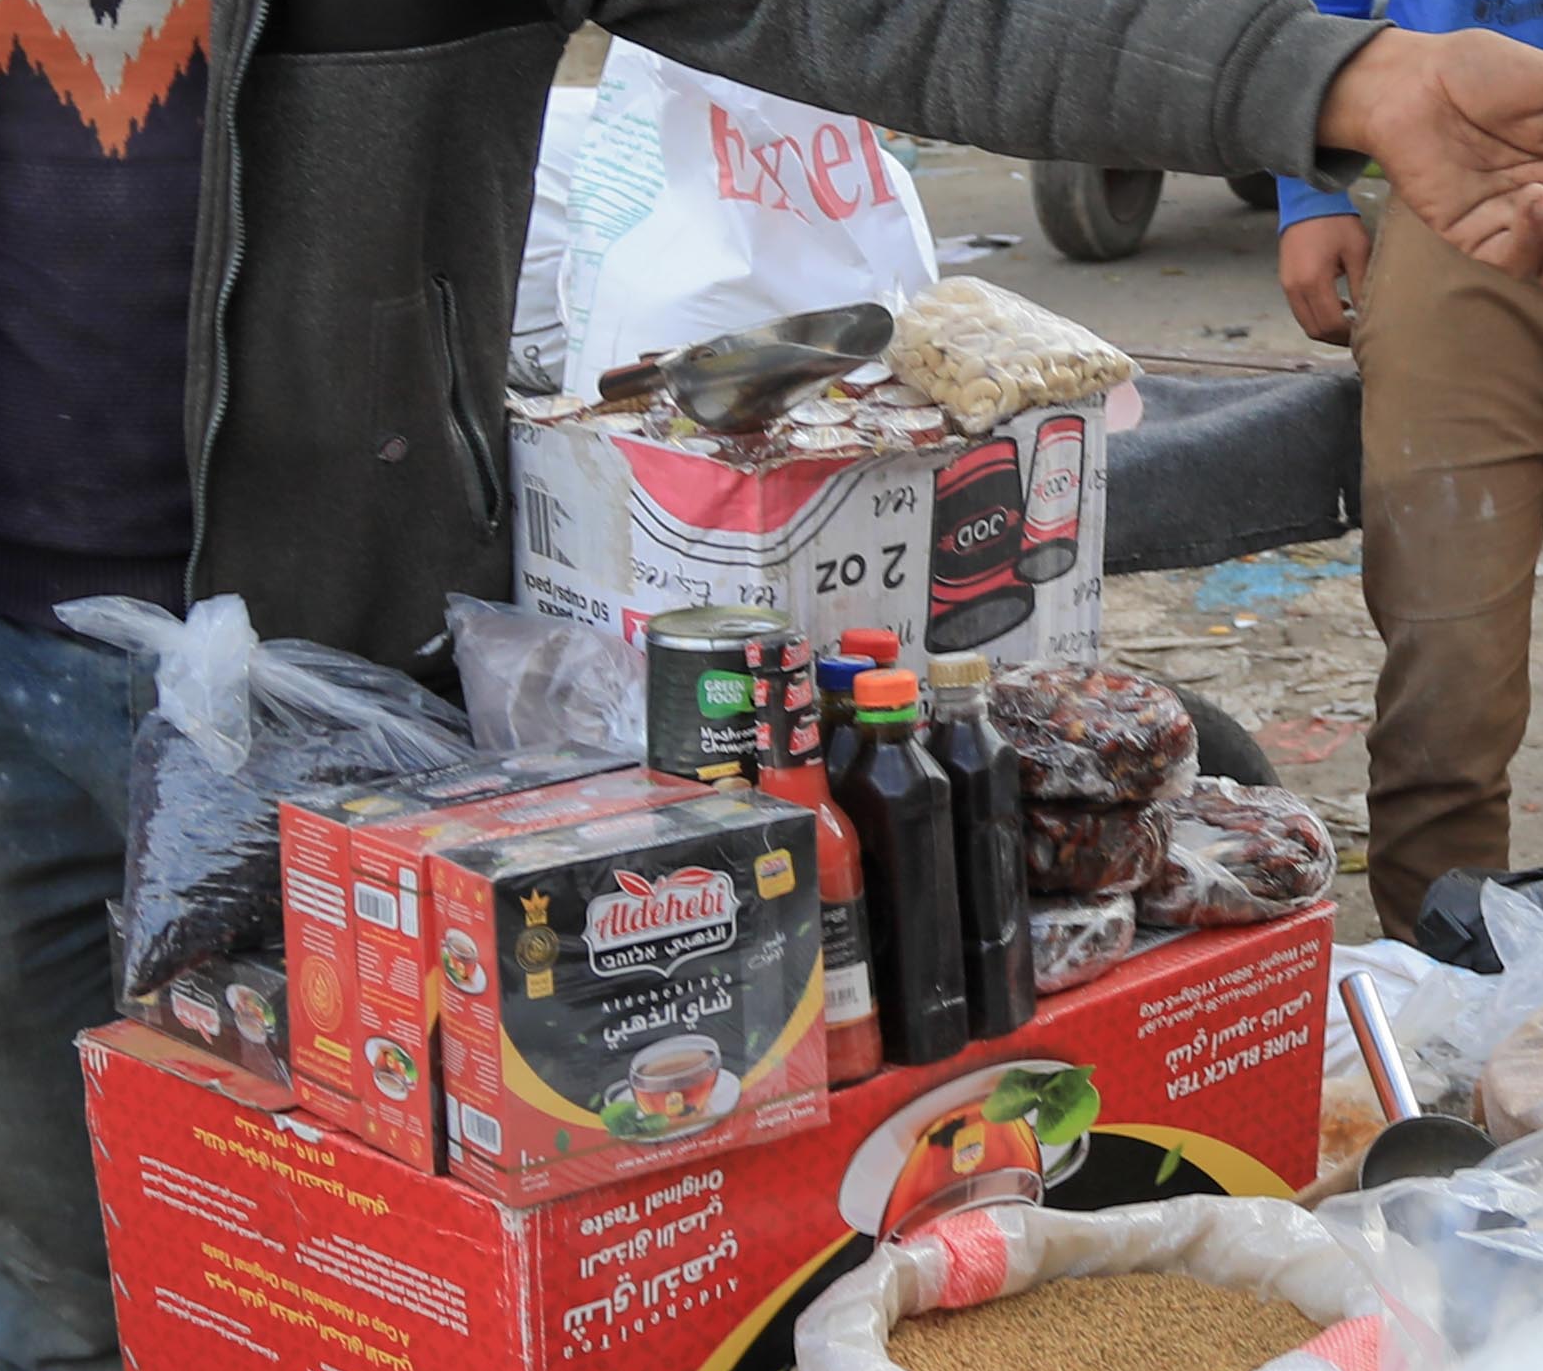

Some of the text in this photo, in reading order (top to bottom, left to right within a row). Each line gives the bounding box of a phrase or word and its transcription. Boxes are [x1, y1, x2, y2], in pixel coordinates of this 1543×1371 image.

[956, 511, 1006, 548] JOD
[881, 542, 907, 590] 2
[590, 600, 610, 624] 50
[704, 679, 745, 692] GREEN
[706, 692, 743, 704] FOOD
[594, 881, 726, 943] Aldehebi
[602, 989, 733, 1051] شاي الذهبي
[1165, 1026, 1208, 1073] شاي
[1210, 1013, 1259, 1058] أسود
[1260, 989, 1314, 1033] خالص
[1164, 1024, 1310, 1102] PURE BLACK TEA
[261, 1124, 288, 1148] عام
[579, 1168, 725, 1236] Original Taste
[580, 1193, 725, 1279] المذاق الأصلي
[237, 1286, 268, 1309] شاي
[561, 1271, 637, 1342] شاي
[642, 1228, 740, 1309] الذهبي
[371, 1316, 398, 1343] Cup
[399, 1329, 410, 1348] A
